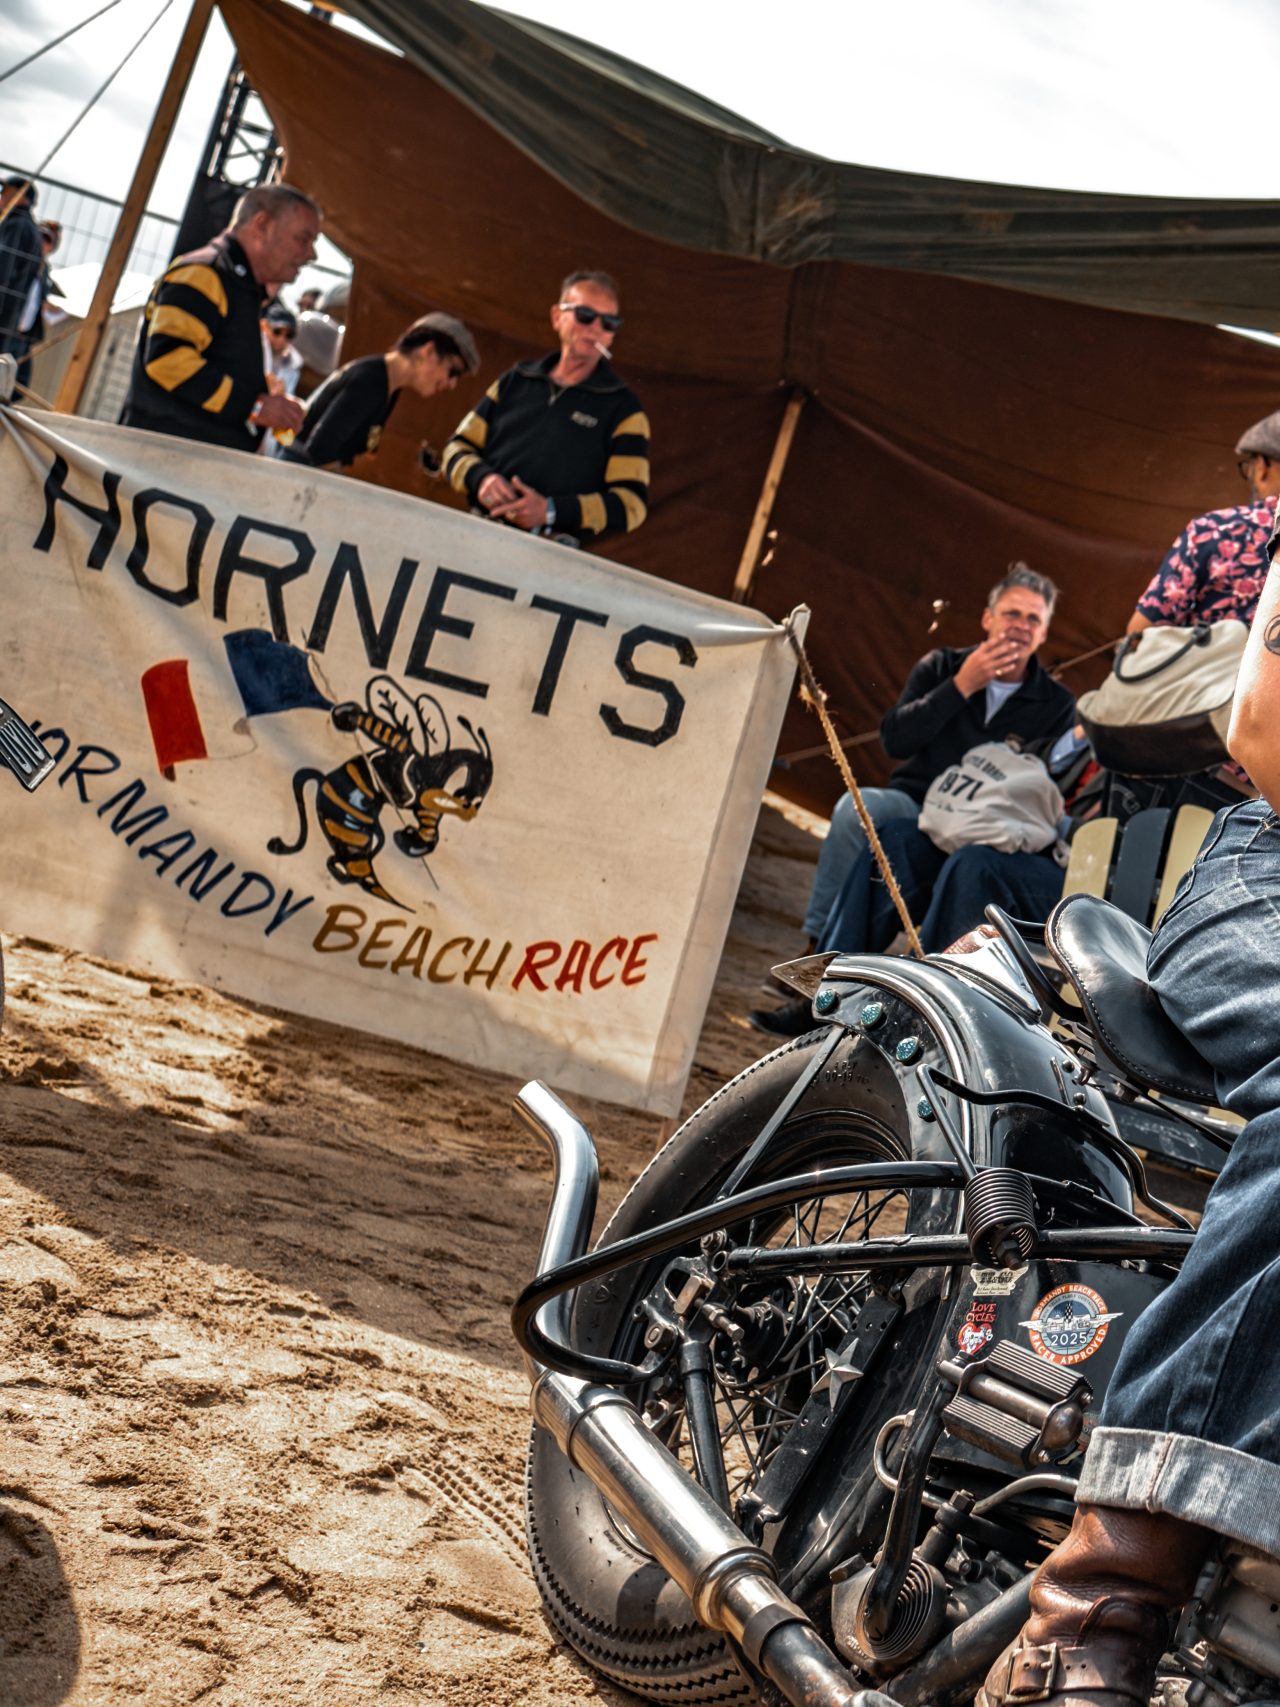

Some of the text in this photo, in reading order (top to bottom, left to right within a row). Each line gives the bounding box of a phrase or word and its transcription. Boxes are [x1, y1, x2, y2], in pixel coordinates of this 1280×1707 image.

[33, 454, 698, 748] HORNETS
[937, 772, 985, 801] 1971
[8, 719, 660, 995] ORMANDY BEACH RACE
[971, 1301, 997, 1313] LOVE
[1034, 1285, 1066, 1317] NORMANDY
[1069, 1284, 1092, 1295] BEACH
[1091, 1293, 1106, 1313] RACE
[966, 1312, 997, 1323] CYCLES
[1031, 1329, 1106, 1364] RACER APPROVED
[1050, 1331, 1088, 1346] 2025
